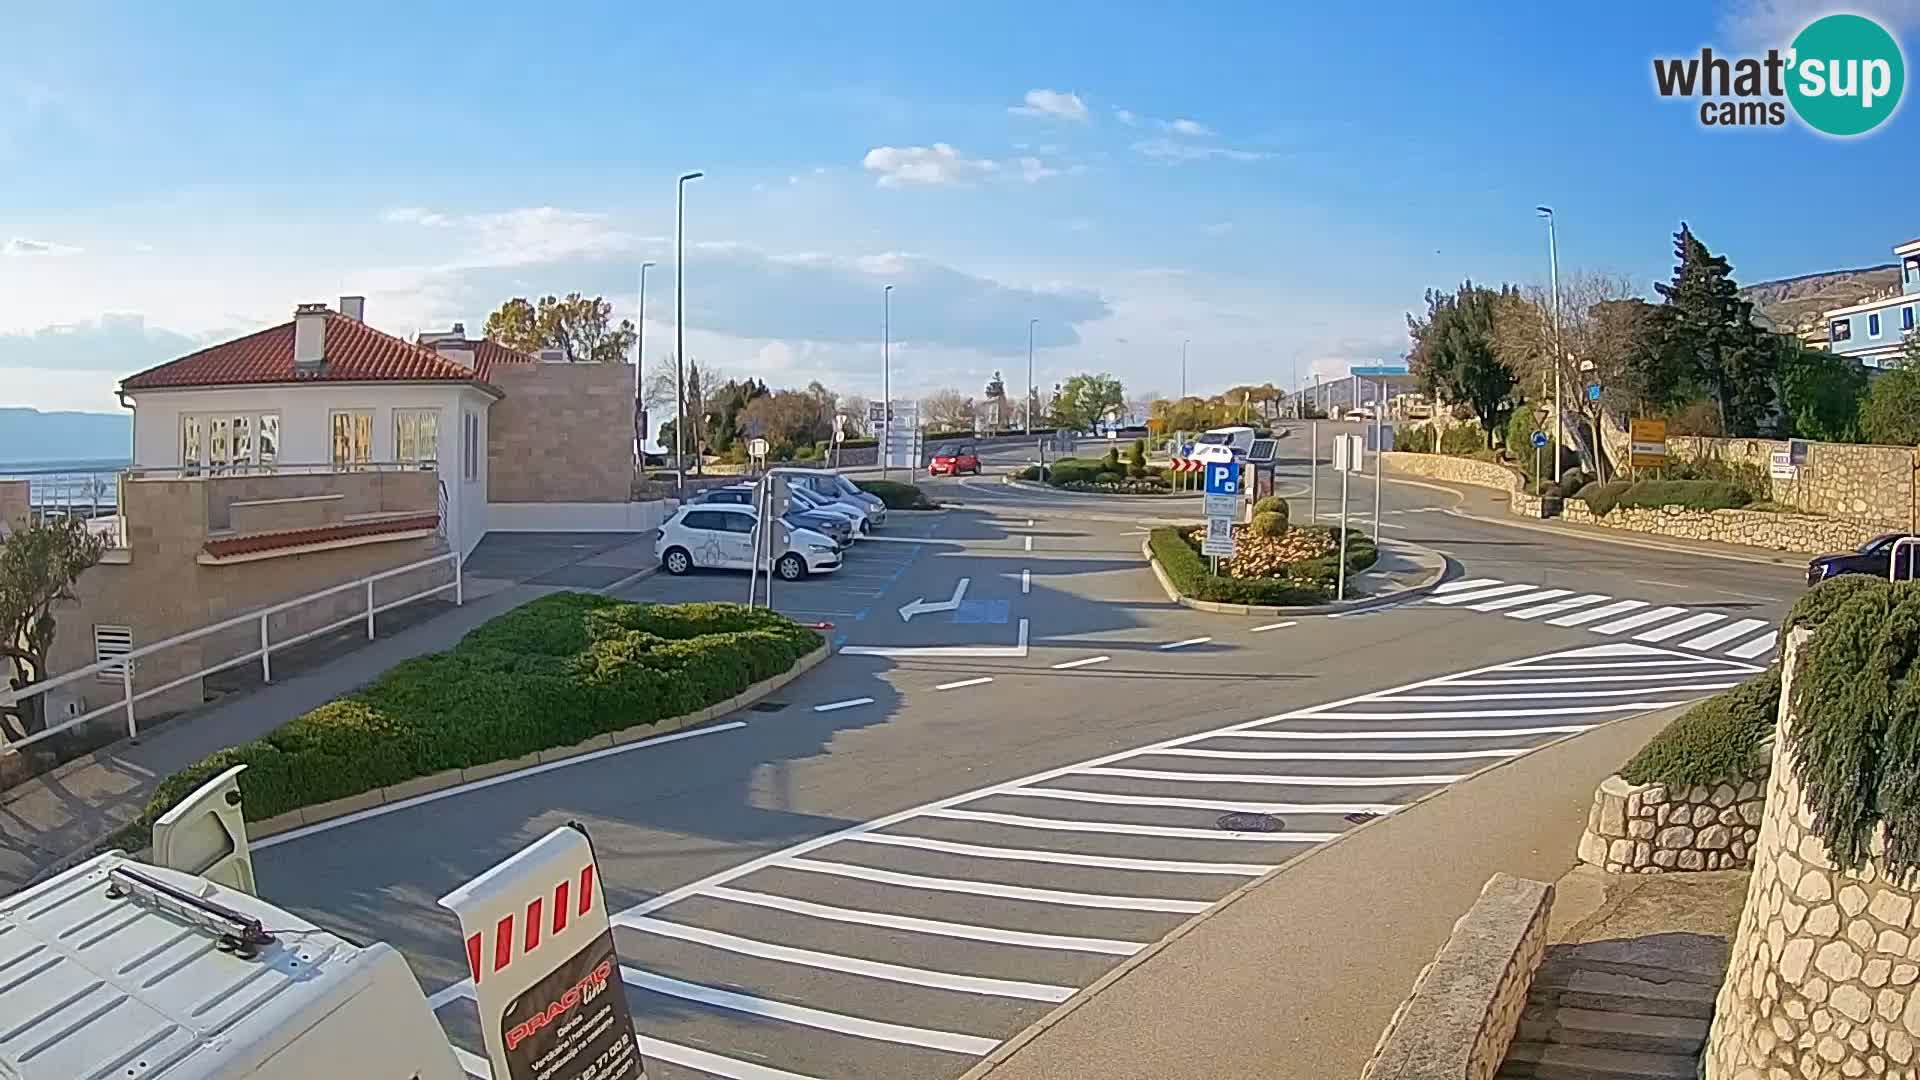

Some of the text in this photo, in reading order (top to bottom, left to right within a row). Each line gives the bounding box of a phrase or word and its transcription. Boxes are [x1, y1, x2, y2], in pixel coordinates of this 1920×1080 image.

[1215, 467, 1229, 488] P
[505, 960, 612, 1051] PRACTIC
[583, 979, 608, 1006] line
[596, 1052, 609, 1069] 77
[608, 1040, 623, 1058] 00
